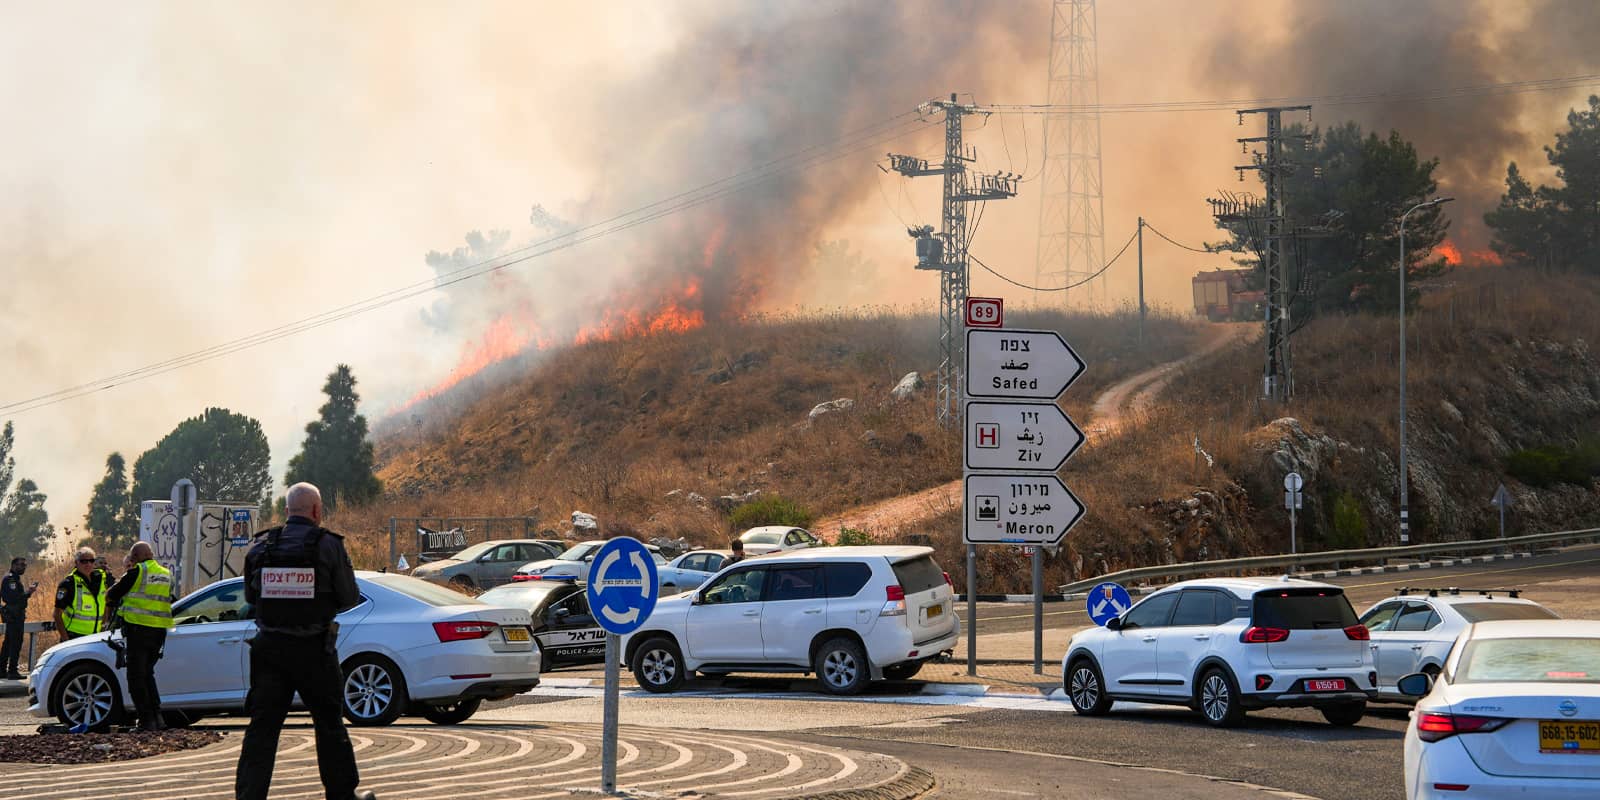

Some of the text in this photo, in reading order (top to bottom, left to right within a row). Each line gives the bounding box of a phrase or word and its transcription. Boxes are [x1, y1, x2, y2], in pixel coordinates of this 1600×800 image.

[976, 306, 993, 318] 89
[1000, 339, 1030, 352] צפת
[1001, 360, 1029, 370] صفد
[992, 376, 1038, 390] Safed
[1021, 411, 1039, 424] זיו
[1018, 449, 1041, 461] Ziv
[1011, 483, 1049, 498] מירון
[1008, 502, 1051, 515] ميرون
[1006, 521, 1054, 534] Meron
[263, 572, 283, 585] צפון
[567, 629, 607, 641] שראל
[556, 648, 582, 656] POLICE
